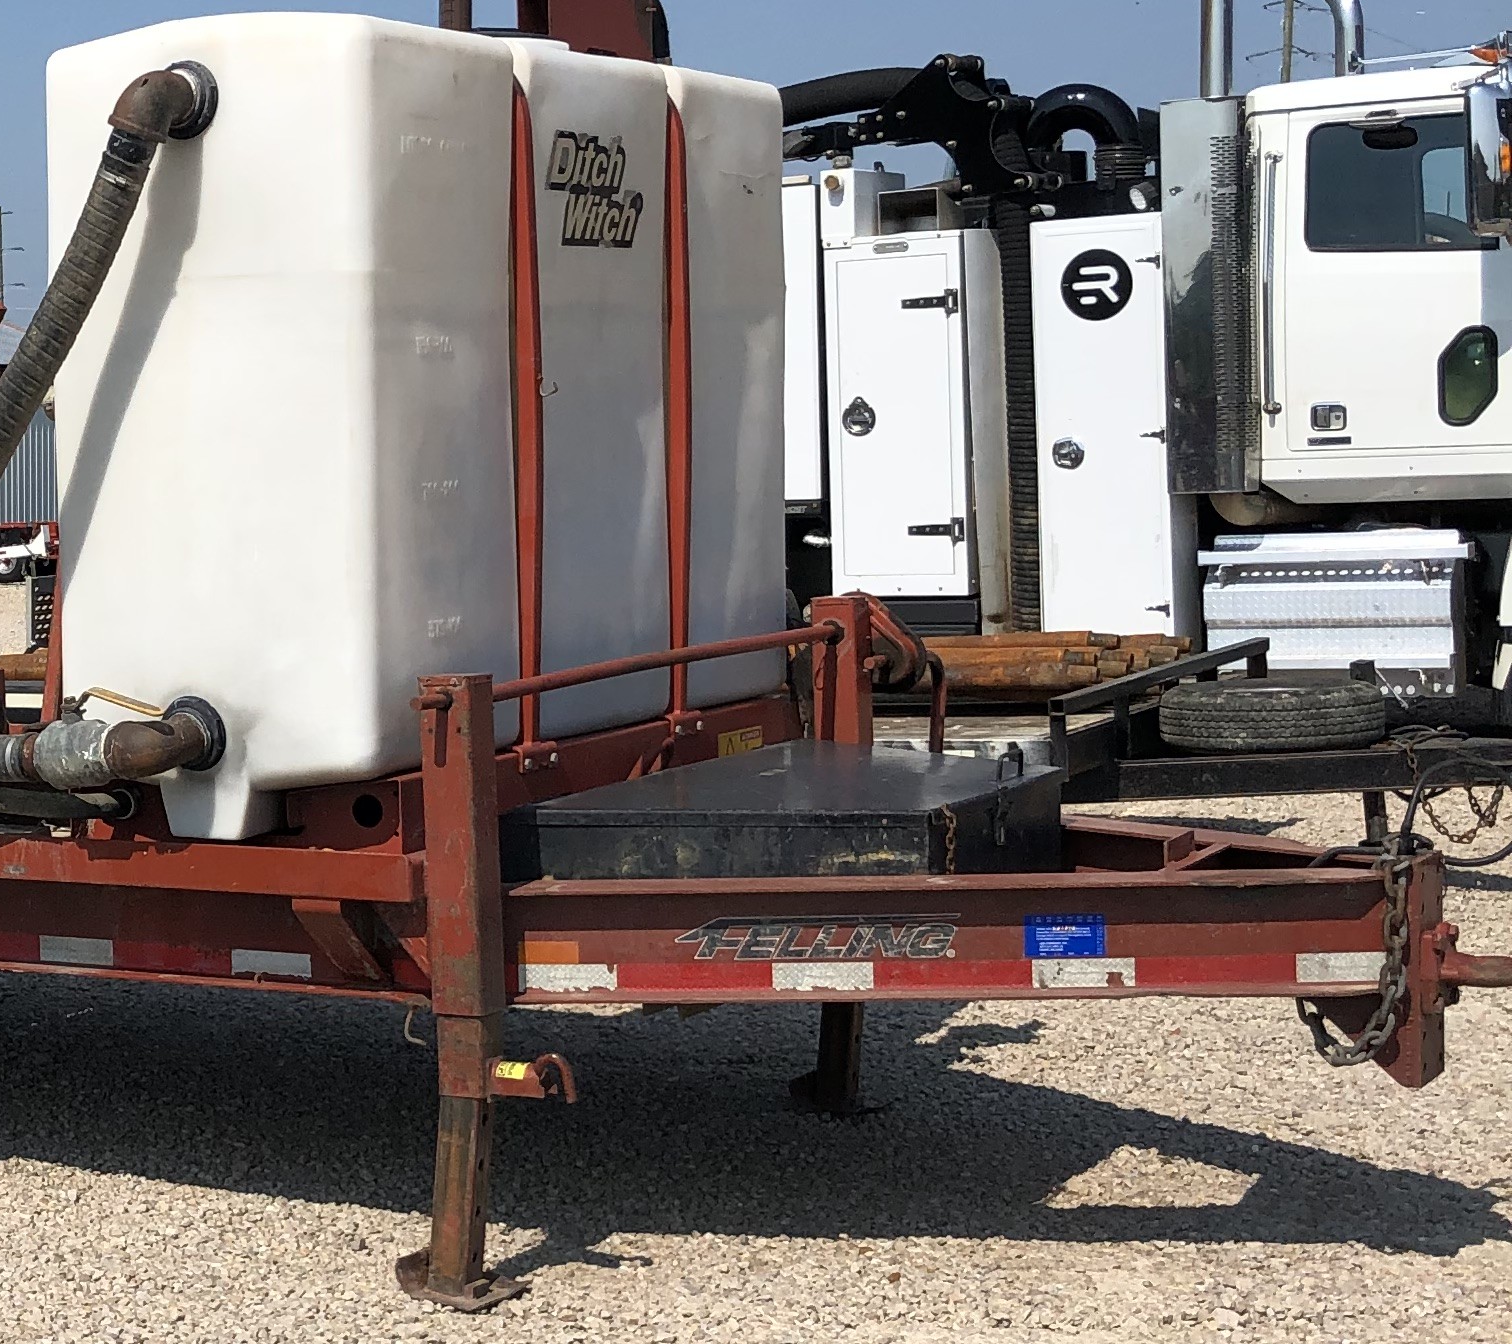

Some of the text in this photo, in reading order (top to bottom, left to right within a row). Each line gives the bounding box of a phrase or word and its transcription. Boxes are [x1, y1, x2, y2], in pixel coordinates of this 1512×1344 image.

[548, 133, 625, 188] Ditch
[563, 192, 638, 243] Witch
[676, 916, 957, 960] FELLING
